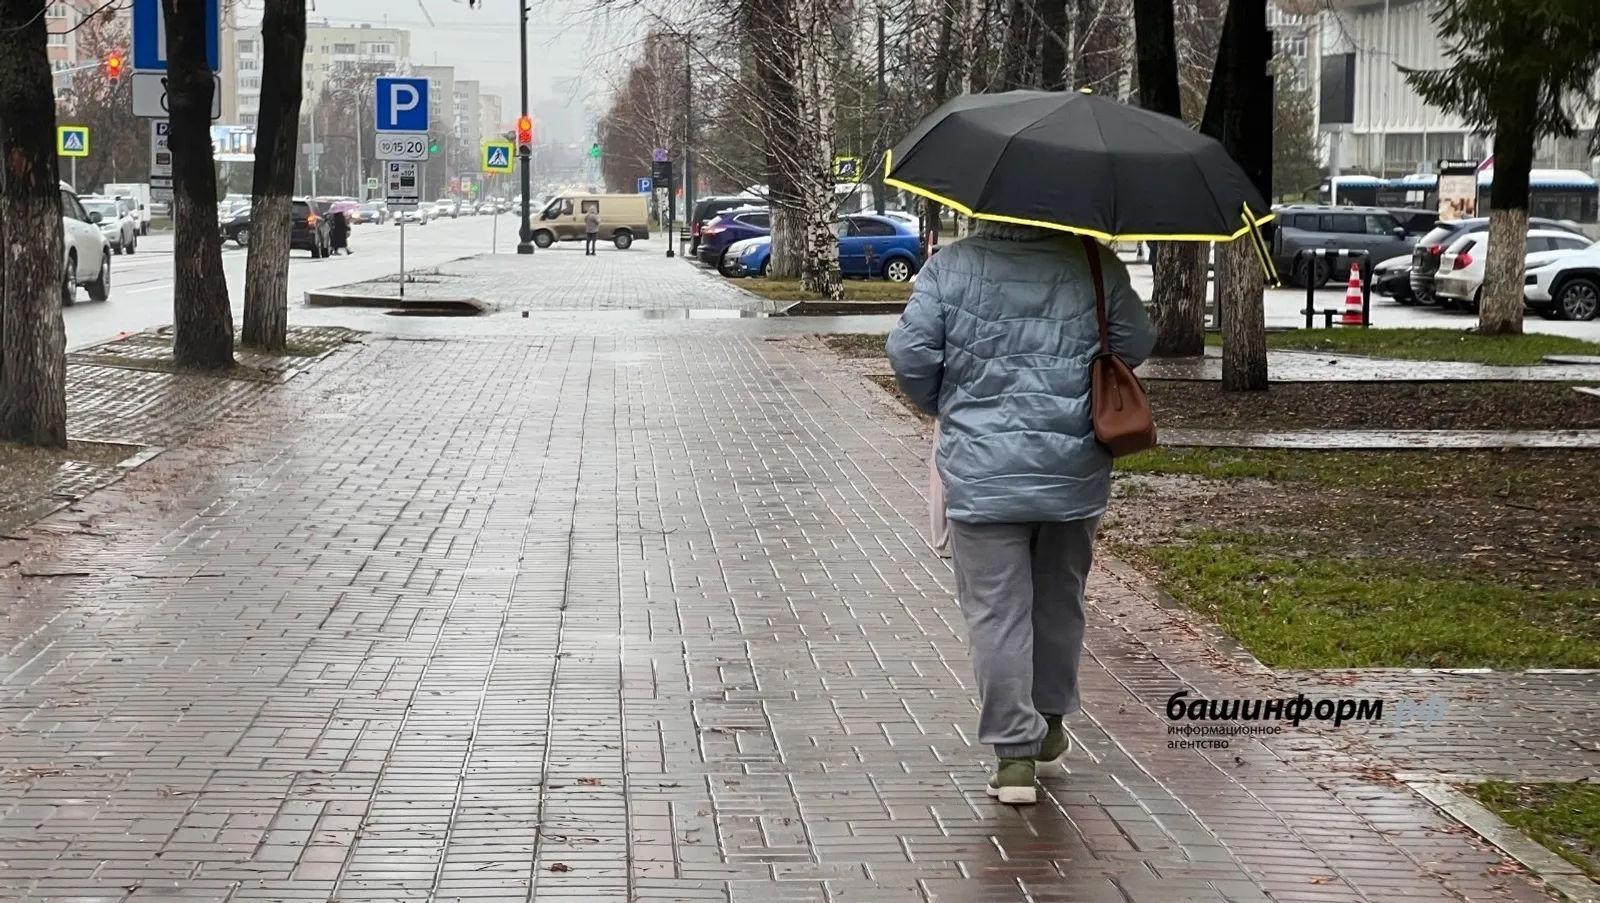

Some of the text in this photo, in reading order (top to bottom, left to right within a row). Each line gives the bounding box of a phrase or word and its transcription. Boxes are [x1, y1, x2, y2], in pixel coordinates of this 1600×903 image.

[390, 84, 419, 125] P
[382, 142, 422, 153] 10 15 20
[642, 180, 649, 190] P
